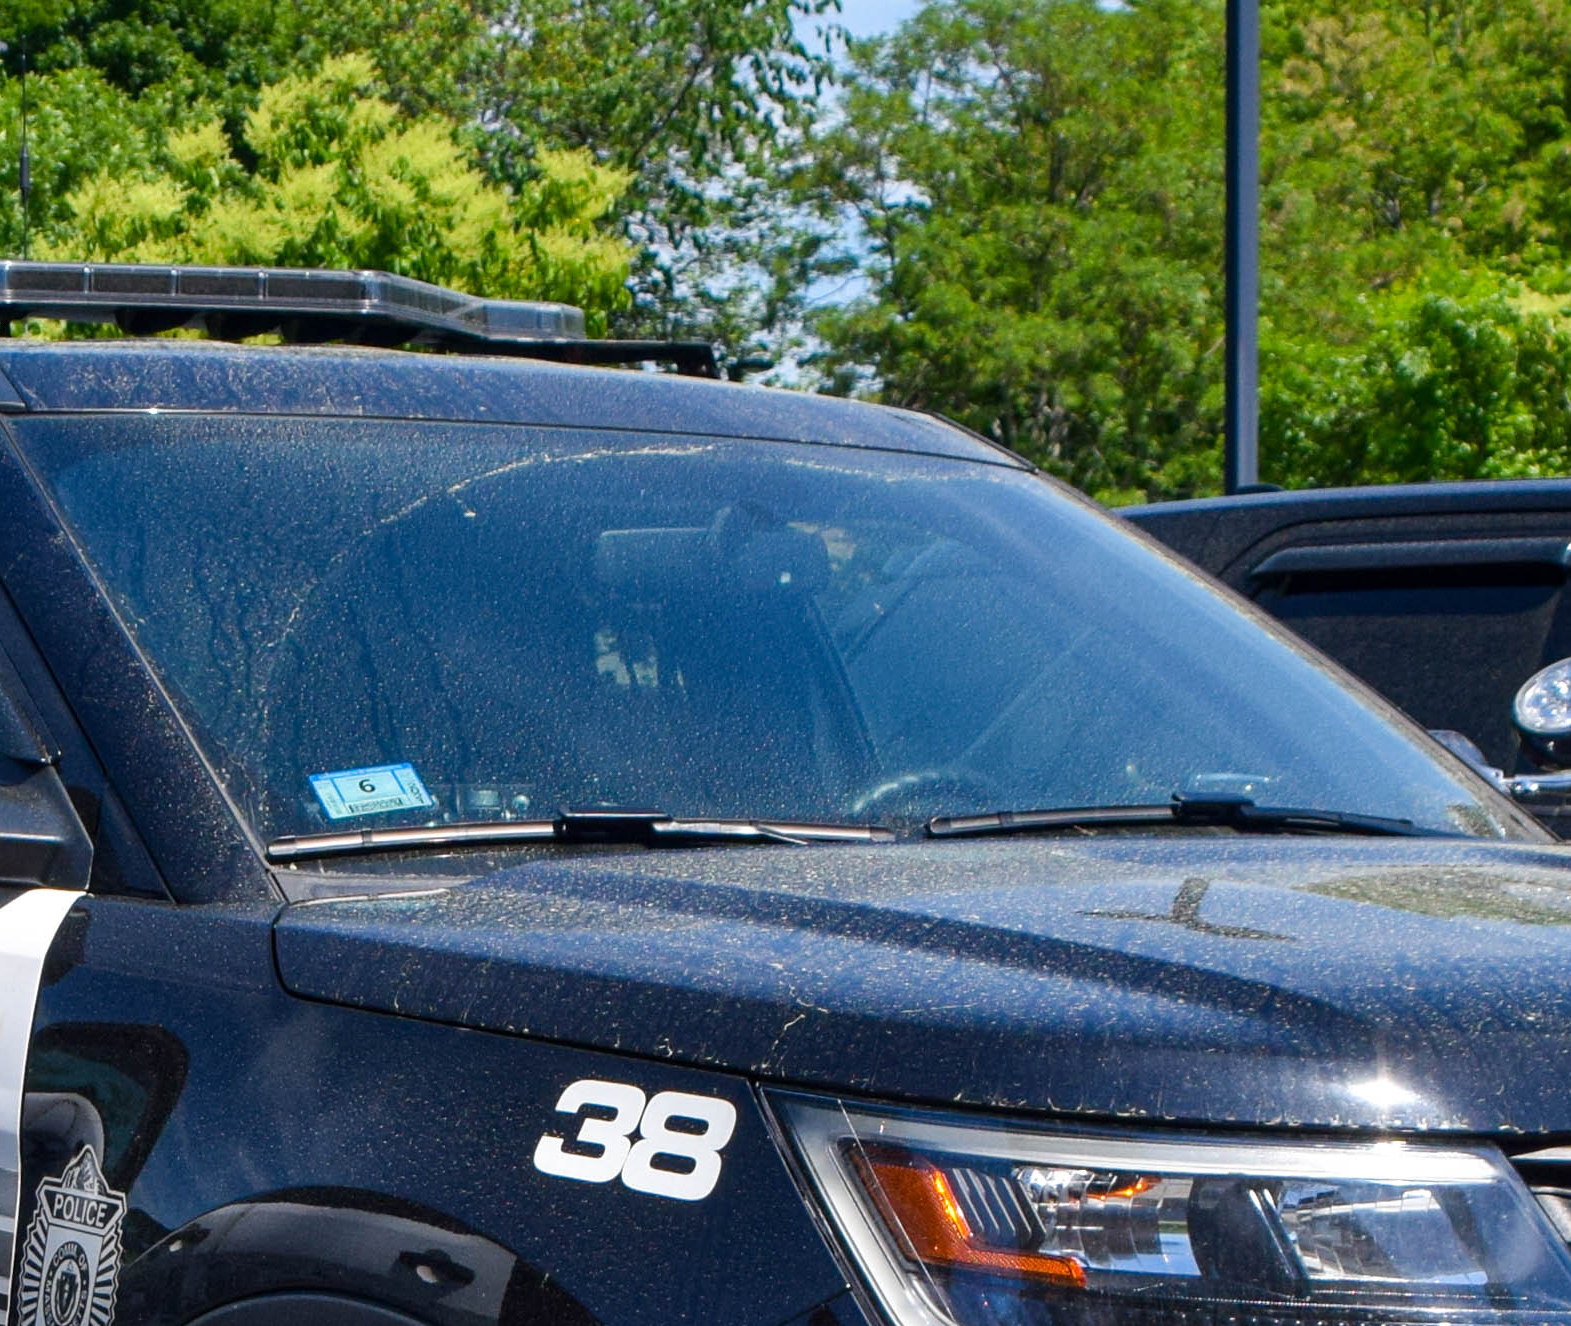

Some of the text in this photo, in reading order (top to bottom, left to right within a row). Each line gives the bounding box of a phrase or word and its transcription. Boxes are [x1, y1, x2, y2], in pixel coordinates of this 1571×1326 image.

[358, 778, 376, 793] 6
[533, 1079, 737, 1201] 38
[53, 1193, 108, 1228] POLICE
